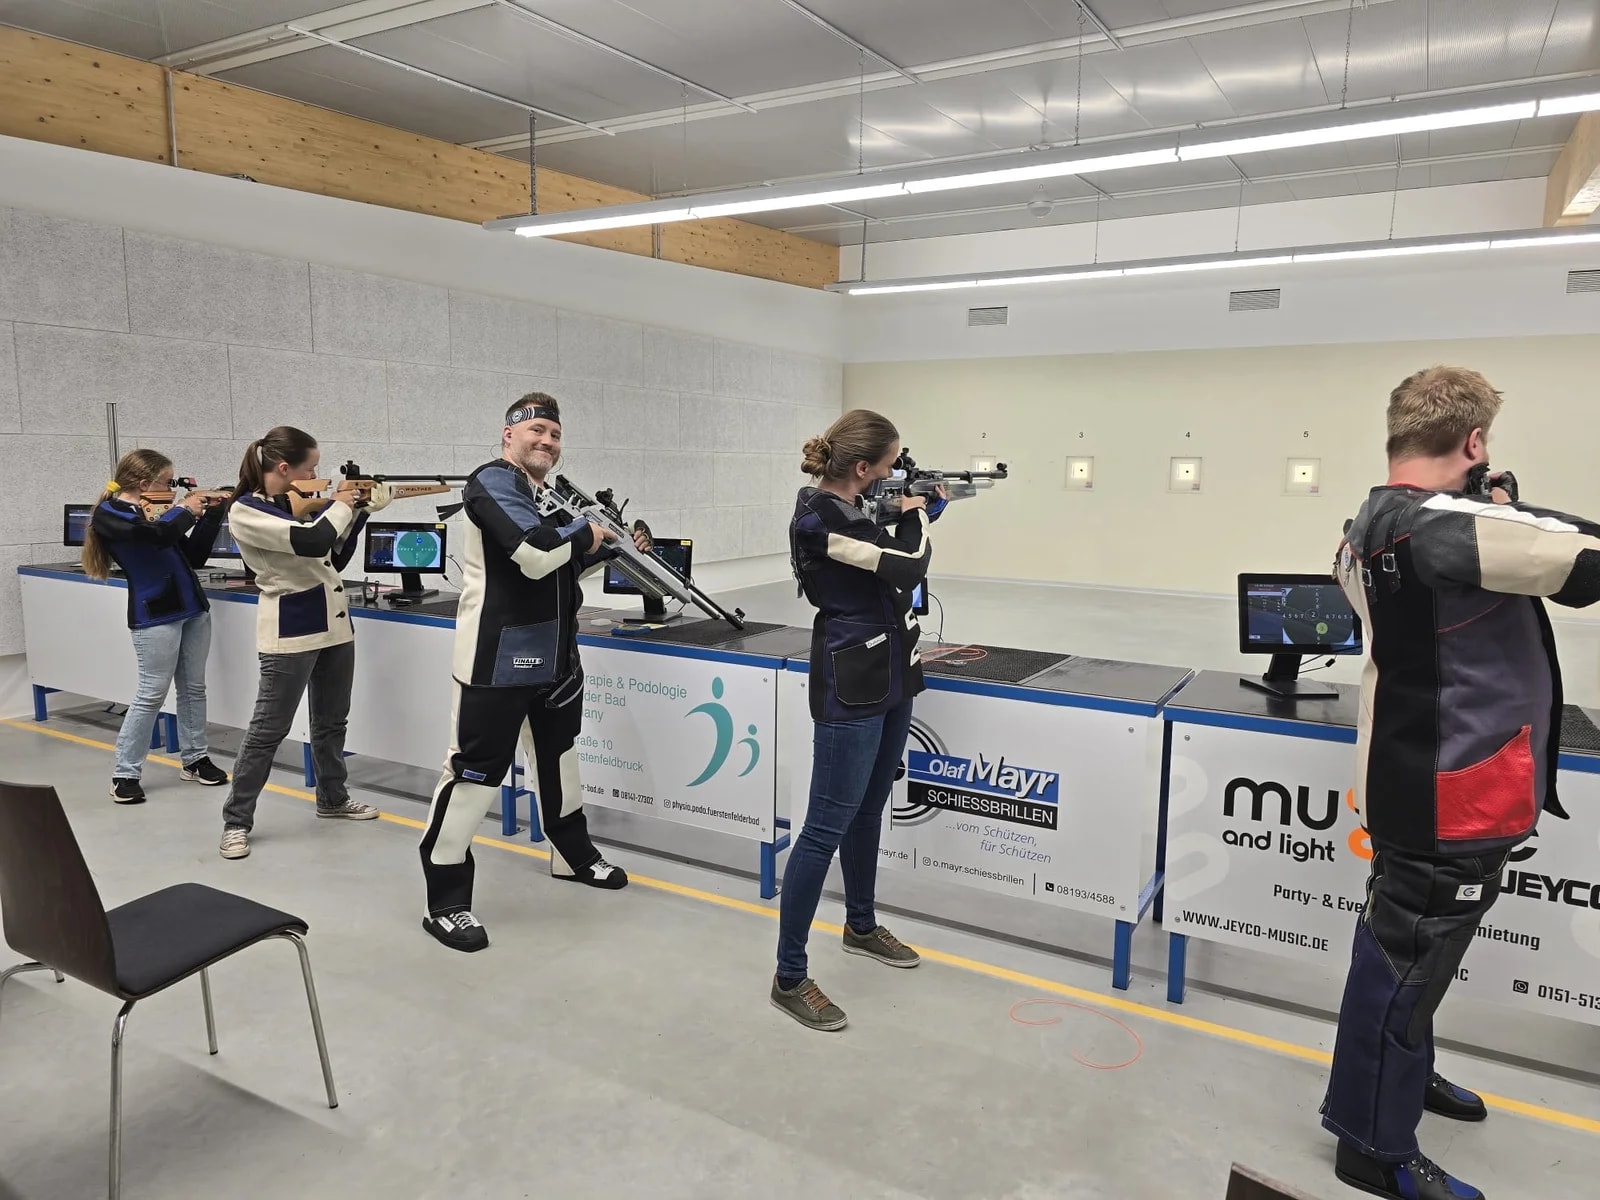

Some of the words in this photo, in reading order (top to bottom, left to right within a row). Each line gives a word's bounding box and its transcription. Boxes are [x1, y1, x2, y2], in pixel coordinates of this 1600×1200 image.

[1079, 431, 1084, 439] 3
[1303, 430, 1309, 438] 5
[584, 690, 602, 703] der
[604, 692, 626, 707] Bad
[585, 674, 613, 689] rapie
[616, 676, 624, 690] &
[629, 678, 687, 700] Podologie
[584, 708, 604, 723] any
[602, 739, 613, 751] 10
[577, 752, 644, 773] rstenfeldbruck
[928, 759, 967, 780] Olaf
[965, 752, 1055, 799] Mayr
[927, 789, 1054, 825] SCHIESSBRILLEN
[983, 825, 1038, 847] Schützen,
[1221, 829, 1272, 851] and
[1279, 832, 1336, 863] light
[979, 839, 997, 853] für
[998, 843, 1052, 864] Schützen
[932, 859, 1025, 886] o.mayr.schiessbrillen
[1056, 884, 1116, 906] 08193/4588
[1273, 884, 1318, 906] Party-
[1322, 893, 1334, 909] &
[1337, 896, 1364, 914] Eve
[1182, 909, 1329, 952] WWW.JEYCO-MUSIC.DE
